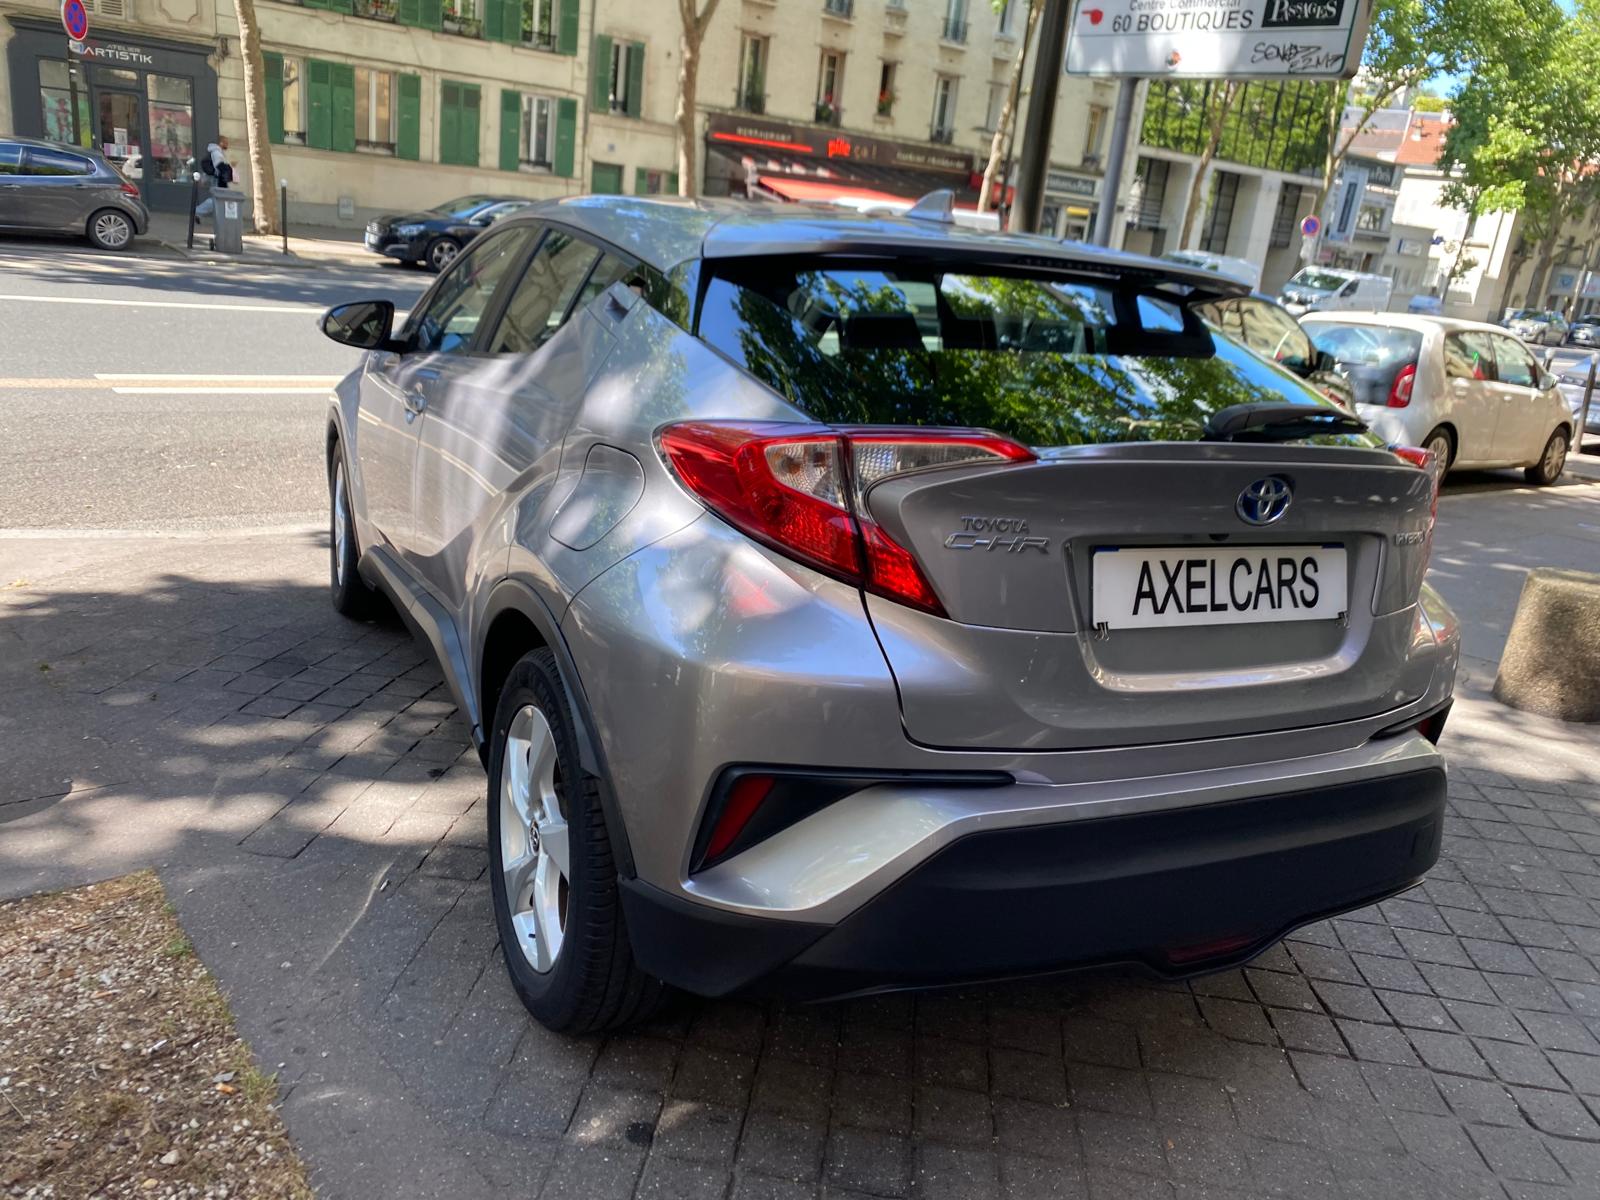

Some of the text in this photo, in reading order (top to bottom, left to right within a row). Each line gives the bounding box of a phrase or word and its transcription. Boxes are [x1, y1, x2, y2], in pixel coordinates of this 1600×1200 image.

[1129, 0, 1165, 11] Centre
[1112, 9, 1254, 33] 60 BOUTIQUES
[83, 46, 153, 64] ARTISTIK
[106, 43, 141, 53] ATELIER
[960, 516, 1030, 534] TOYOTA
[944, 532, 1050, 554] C-HR
[1132, 556, 1319, 616] AXELCARS
